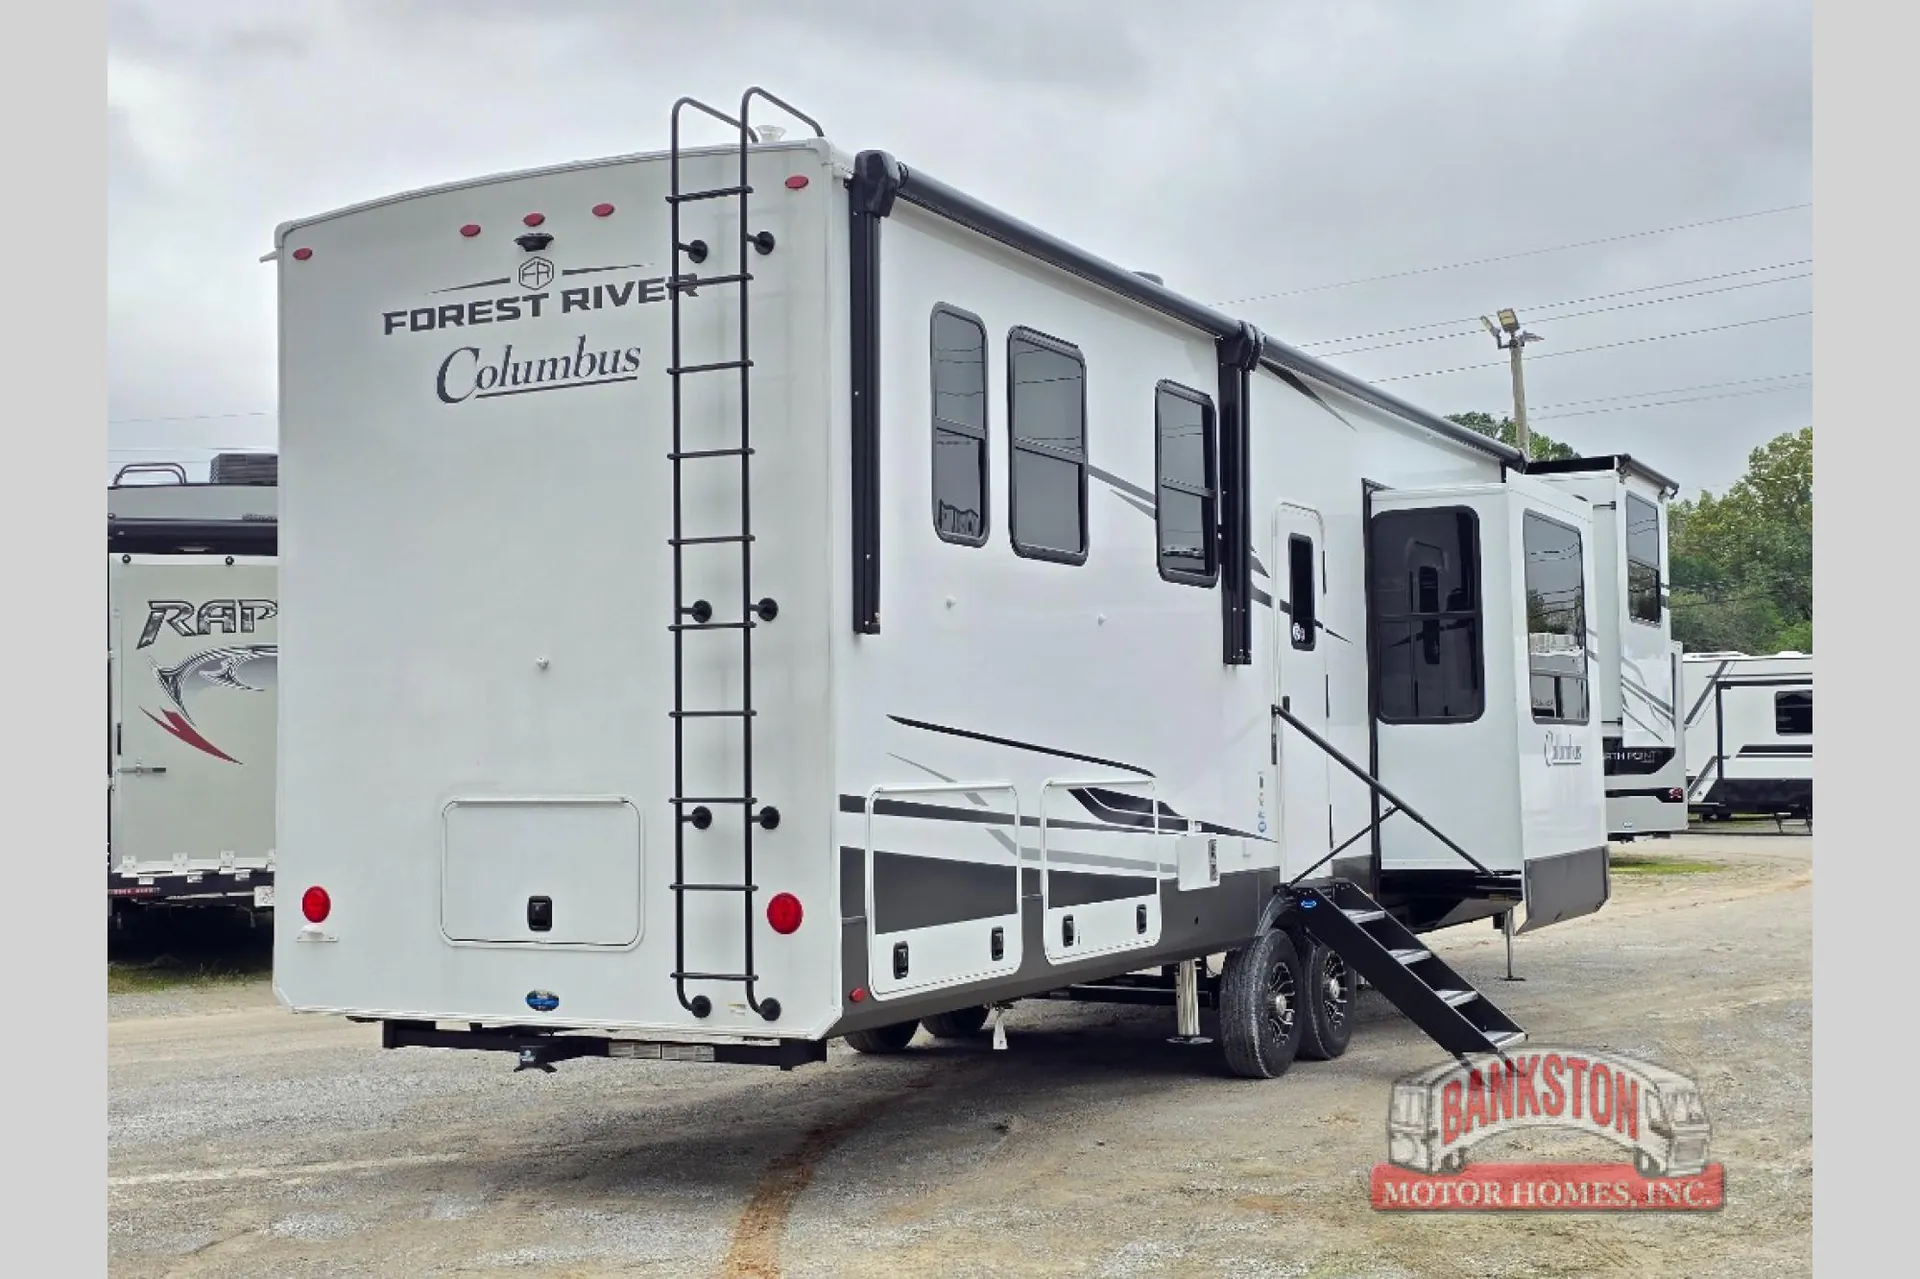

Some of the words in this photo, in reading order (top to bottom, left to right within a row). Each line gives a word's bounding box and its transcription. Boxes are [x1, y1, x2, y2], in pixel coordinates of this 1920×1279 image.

[383, 292, 549, 336] FOREST
[561, 273, 699, 314] RIVER
[436, 335, 641, 404] Columbus
